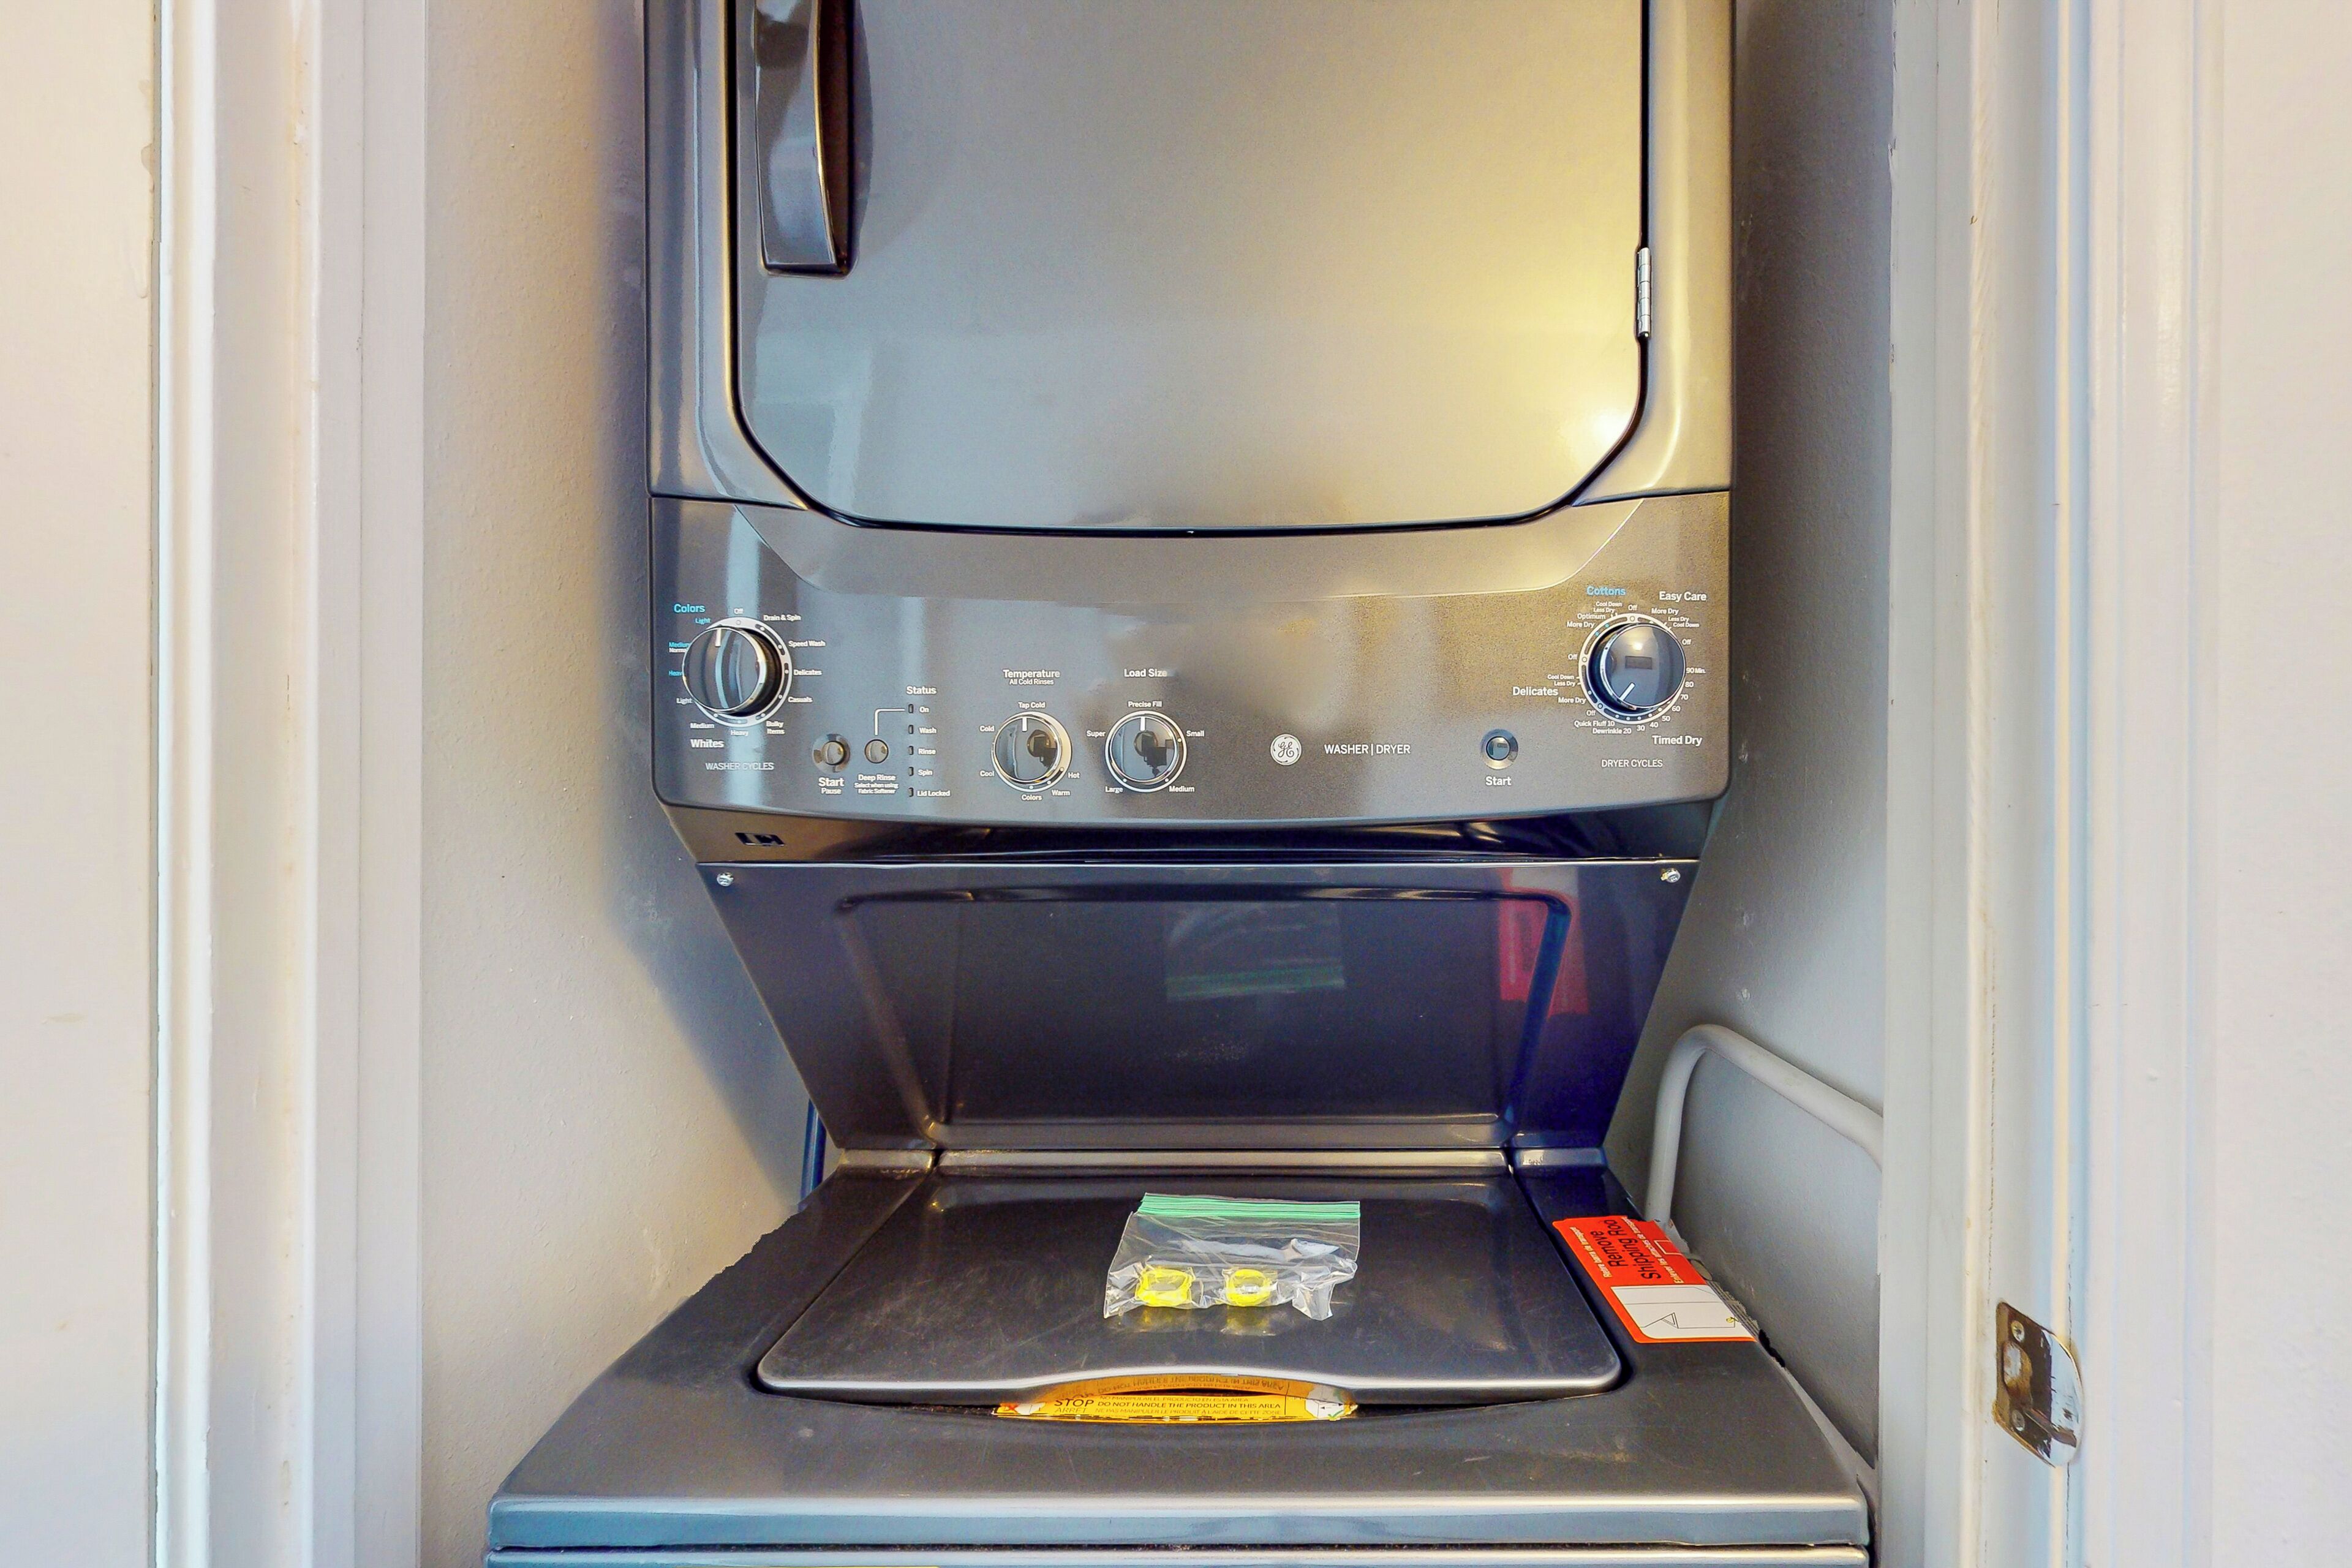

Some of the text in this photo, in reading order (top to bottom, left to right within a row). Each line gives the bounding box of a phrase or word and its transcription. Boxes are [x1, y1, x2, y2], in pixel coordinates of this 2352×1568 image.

[1586, 586, 1626, 596] Cottons
[1659, 592, 1707, 601] Easy Care
[674, 603, 705, 612] Colors
[1003, 669, 1060, 680] Temperature
[1125, 669, 1167, 677] Load Size
[907, 686, 937, 695] Status
[1512, 687, 1558, 696] Delicates
[690, 739, 724, 748] Whites
[1652, 736, 1702, 746] Timed Dry
[1324, 744, 1411, 754] WASHER DRYER
[818, 777, 845, 787] Start
[1485, 777, 1511, 786] Start
[1591, 1231, 1628, 1267] Remove
[1618, 1238, 1662, 1280] Shipping
[1054, 1398, 1095, 1407] STOP
